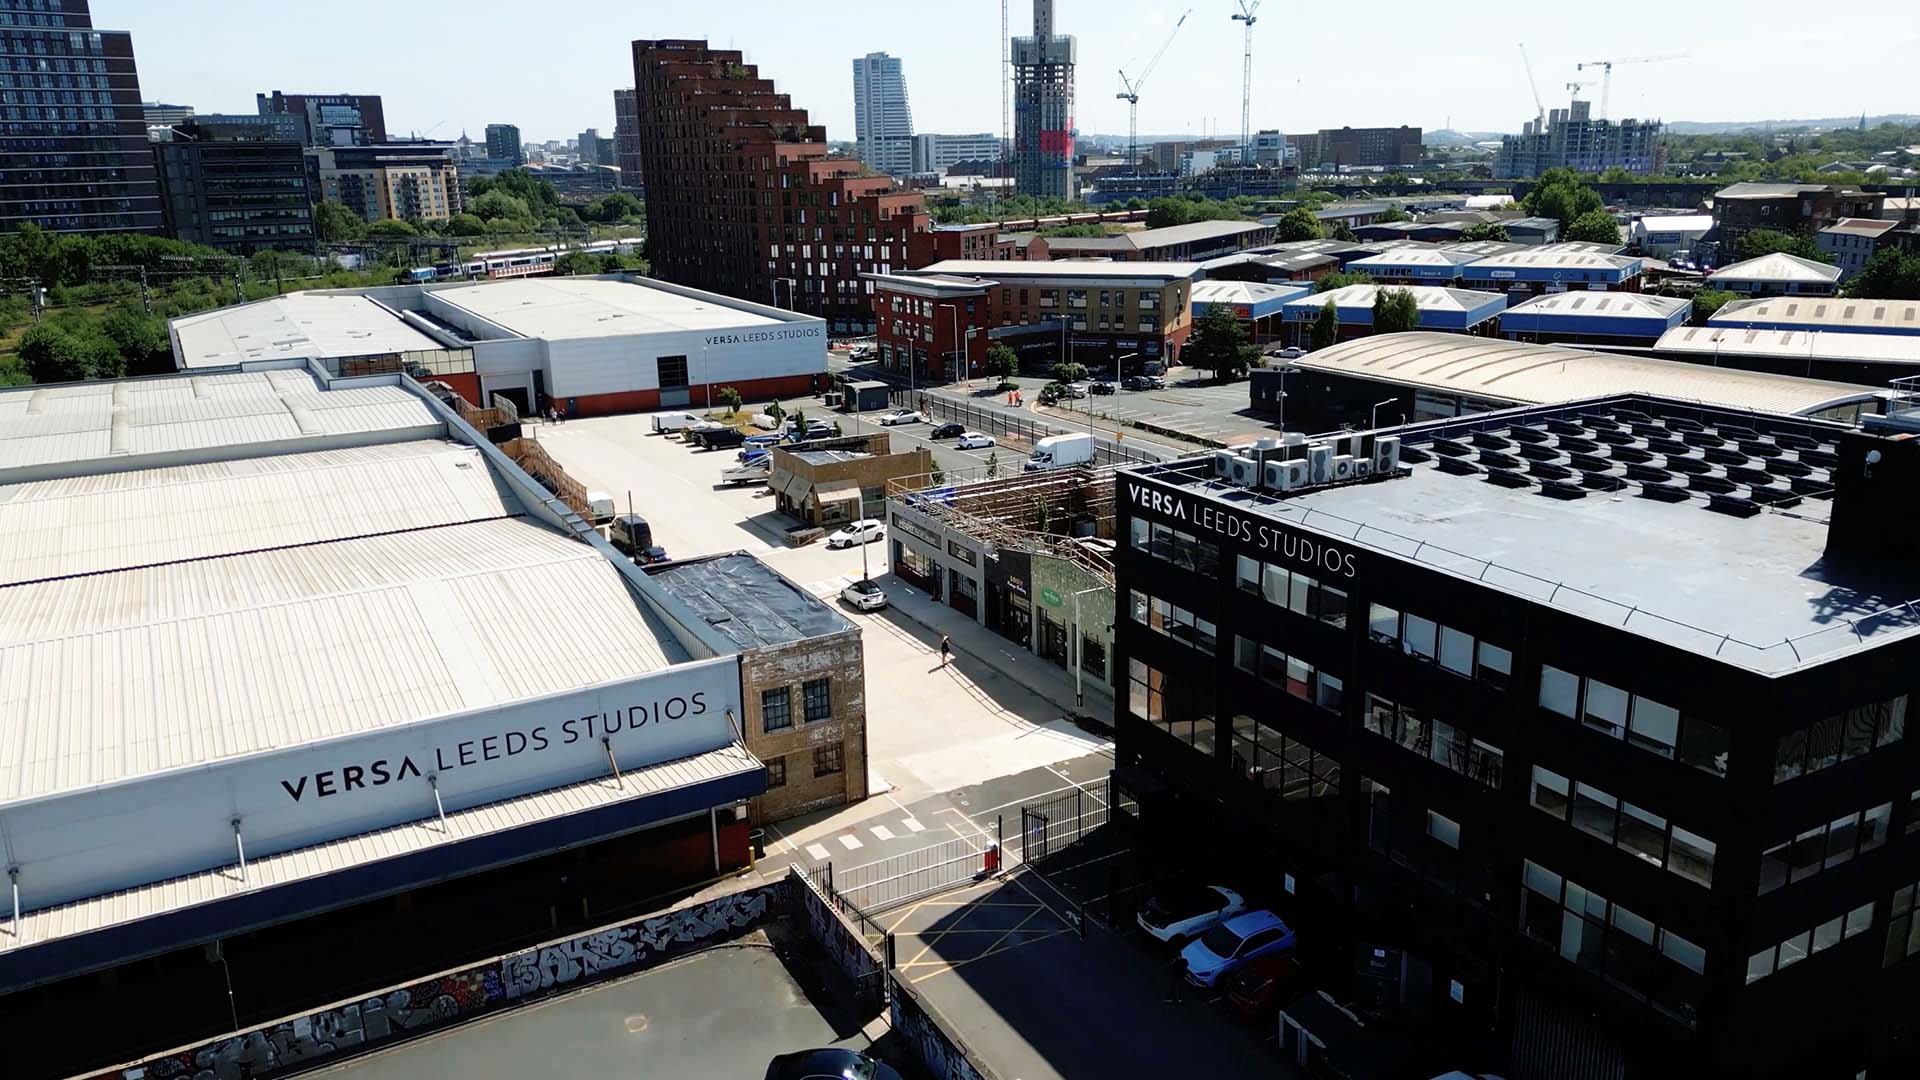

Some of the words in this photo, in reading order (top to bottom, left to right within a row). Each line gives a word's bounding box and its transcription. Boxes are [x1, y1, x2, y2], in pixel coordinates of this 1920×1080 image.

[705, 335, 740, 345] VERSA
[743, 331, 775, 343] LEEDS
[777, 328, 820, 340] STUDIOS
[1128, 482, 1186, 519] VERSA
[1193, 503, 1251, 542] LEEDS
[1259, 525, 1356, 578] STUDIOS
[281, 755, 422, 802] VERSA
[436, 726, 549, 771] LEEDS
[563, 692, 707, 744] STUDIOS
